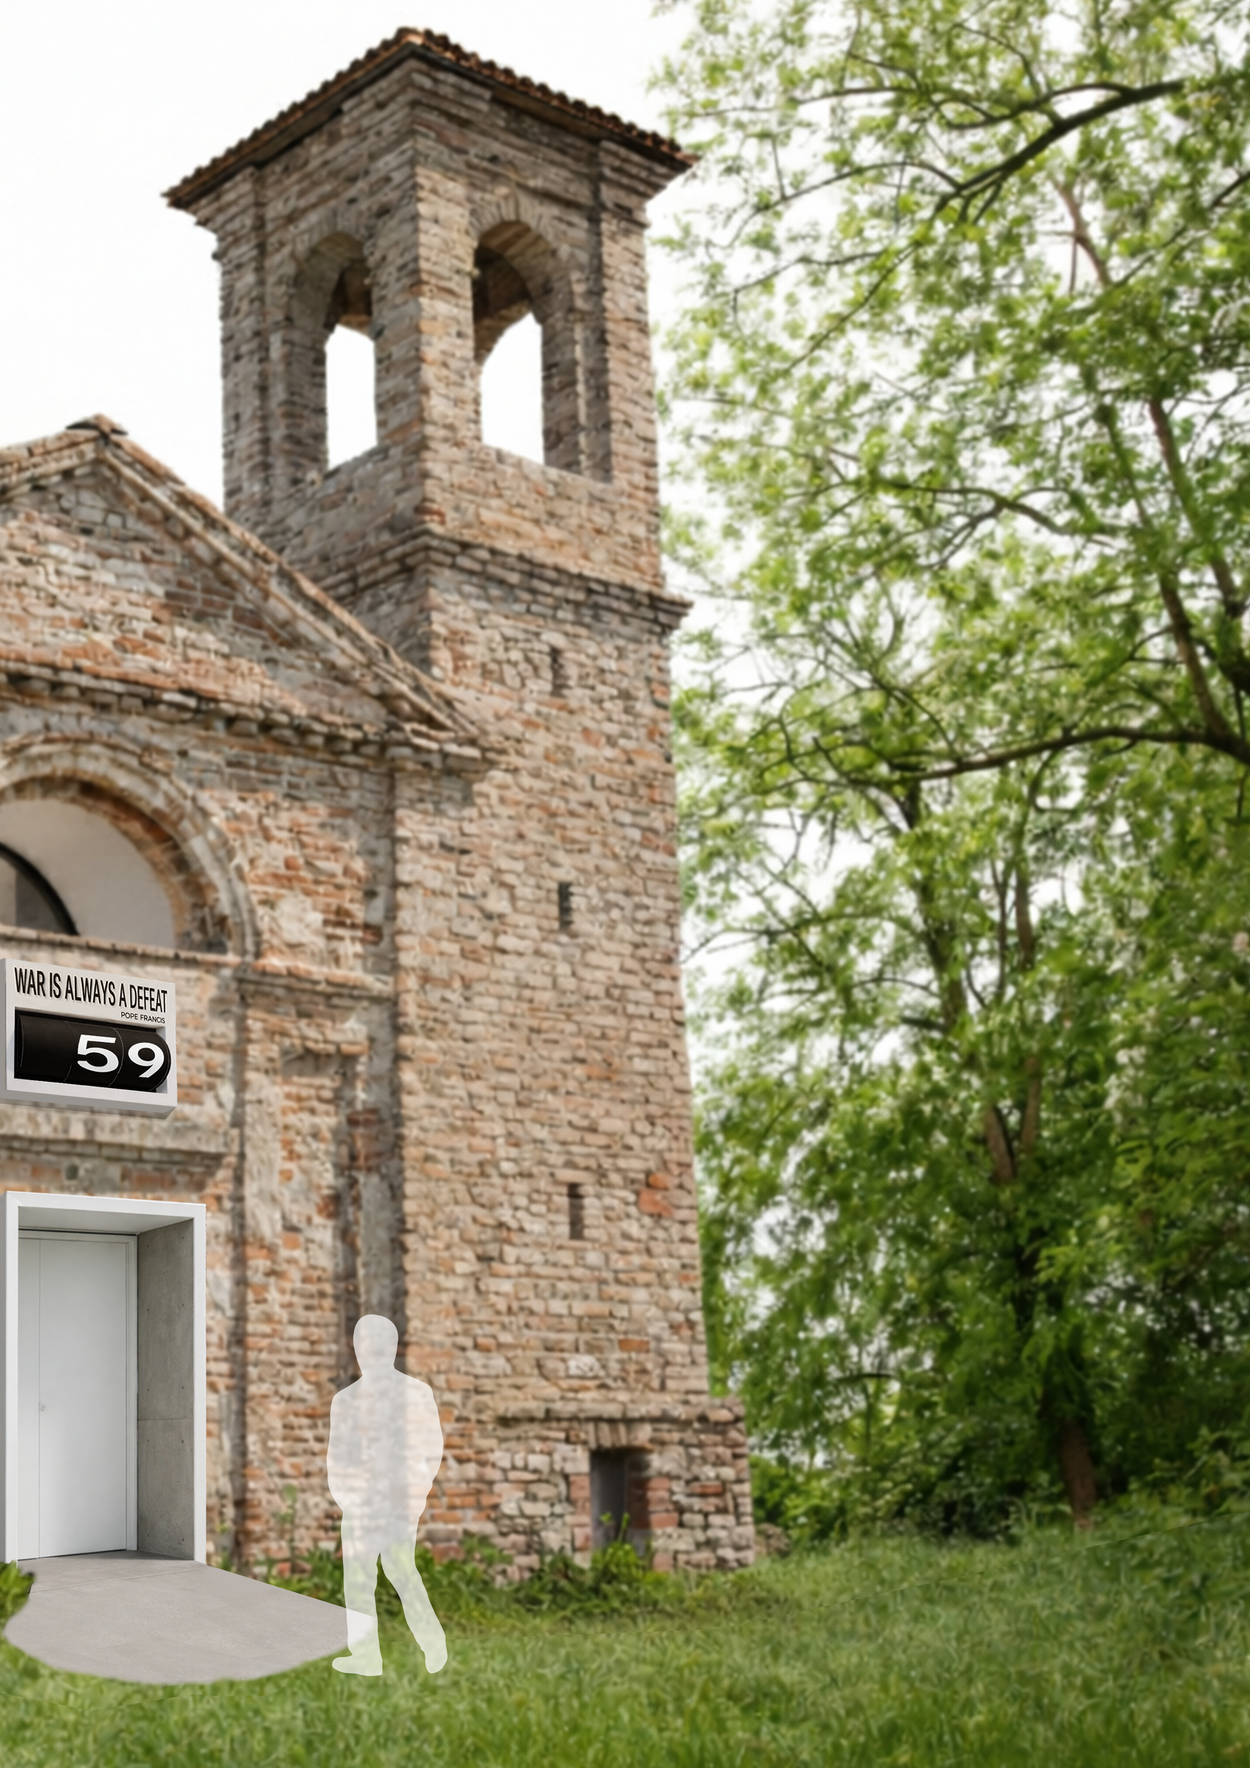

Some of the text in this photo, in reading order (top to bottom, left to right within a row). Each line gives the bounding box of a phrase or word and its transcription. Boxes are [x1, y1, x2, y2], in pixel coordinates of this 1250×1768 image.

[14, 967, 167, 1013] WAR IS ALWAYS A DEFEAT
[121, 1011, 166, 1024] POPE FRANCIS
[77, 1034, 165, 1078] 59
